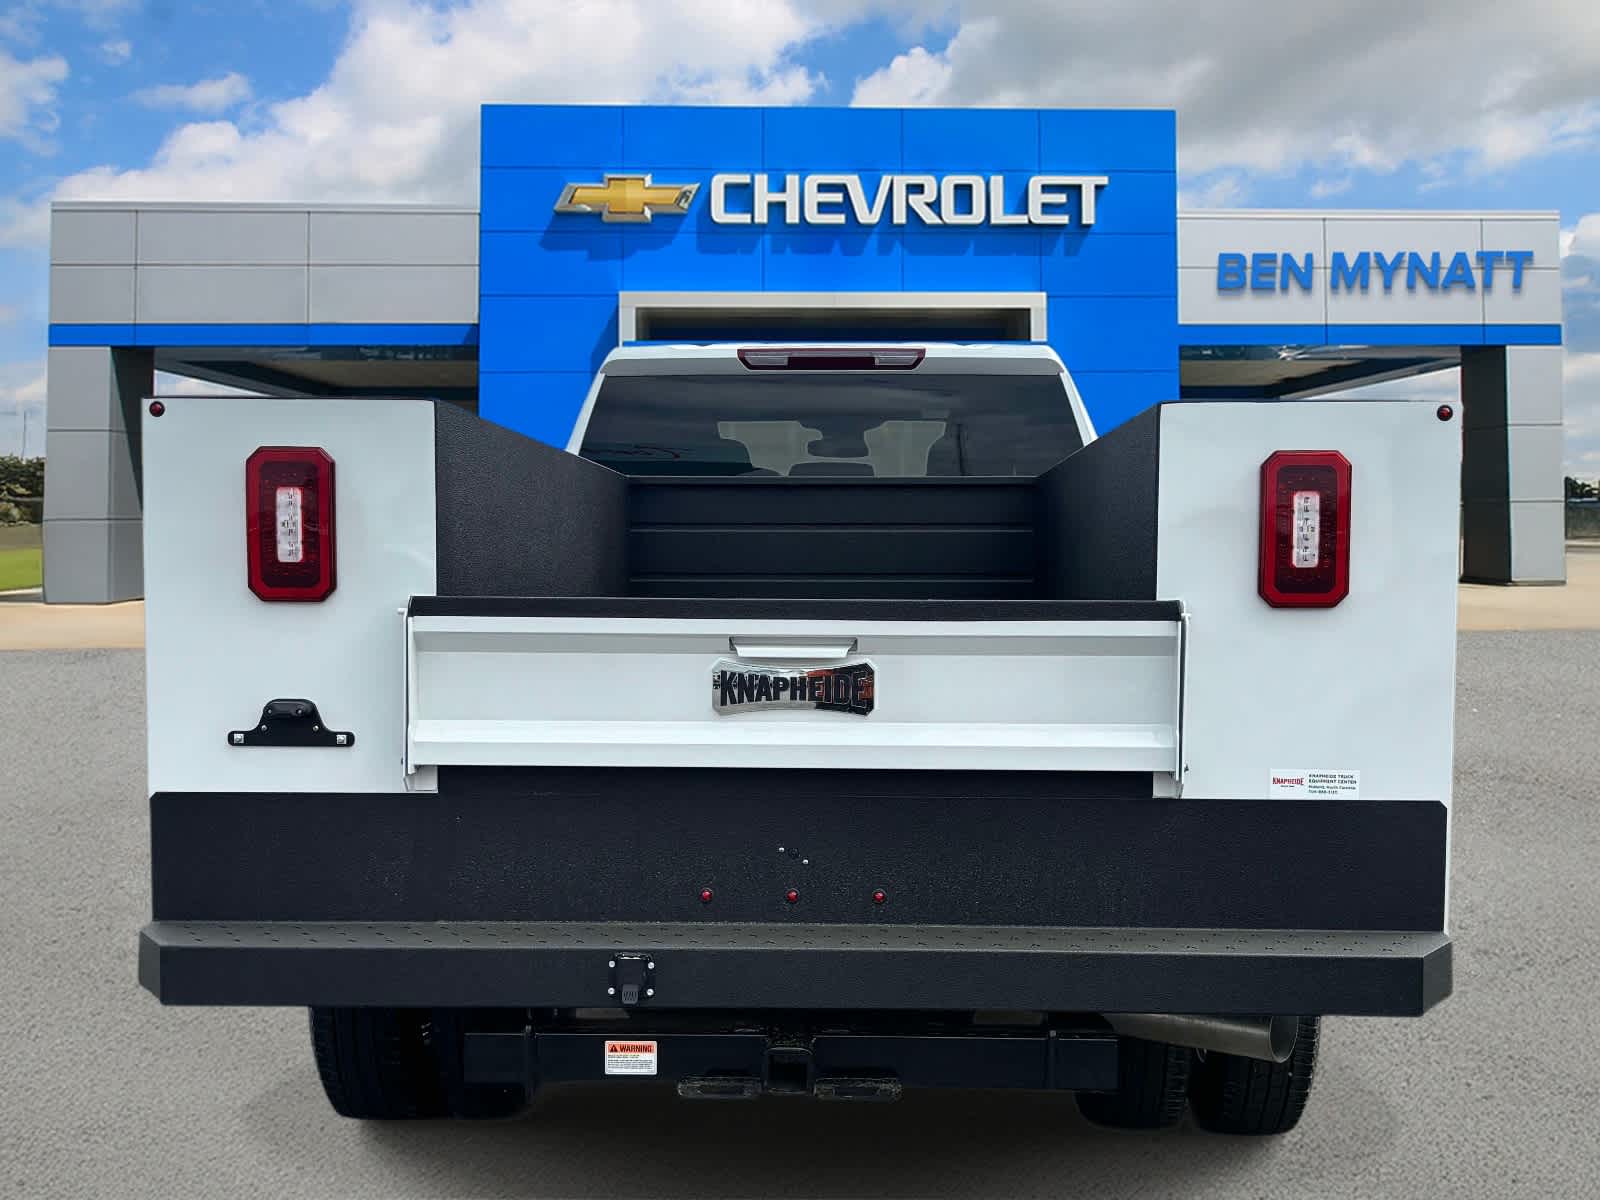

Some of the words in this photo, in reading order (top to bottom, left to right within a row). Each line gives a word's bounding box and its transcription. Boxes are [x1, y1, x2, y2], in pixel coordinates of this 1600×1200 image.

[710, 173, 1109, 225] CHEVROLET
[1217, 252, 1314, 290] BEN
[1330, 251, 1534, 290] MYNATT
[720, 669, 868, 709] KNAPHEIDE
[1272, 777, 1304, 786] KNAPHEIDE
[619, 1044, 653, 1053] WARNING
